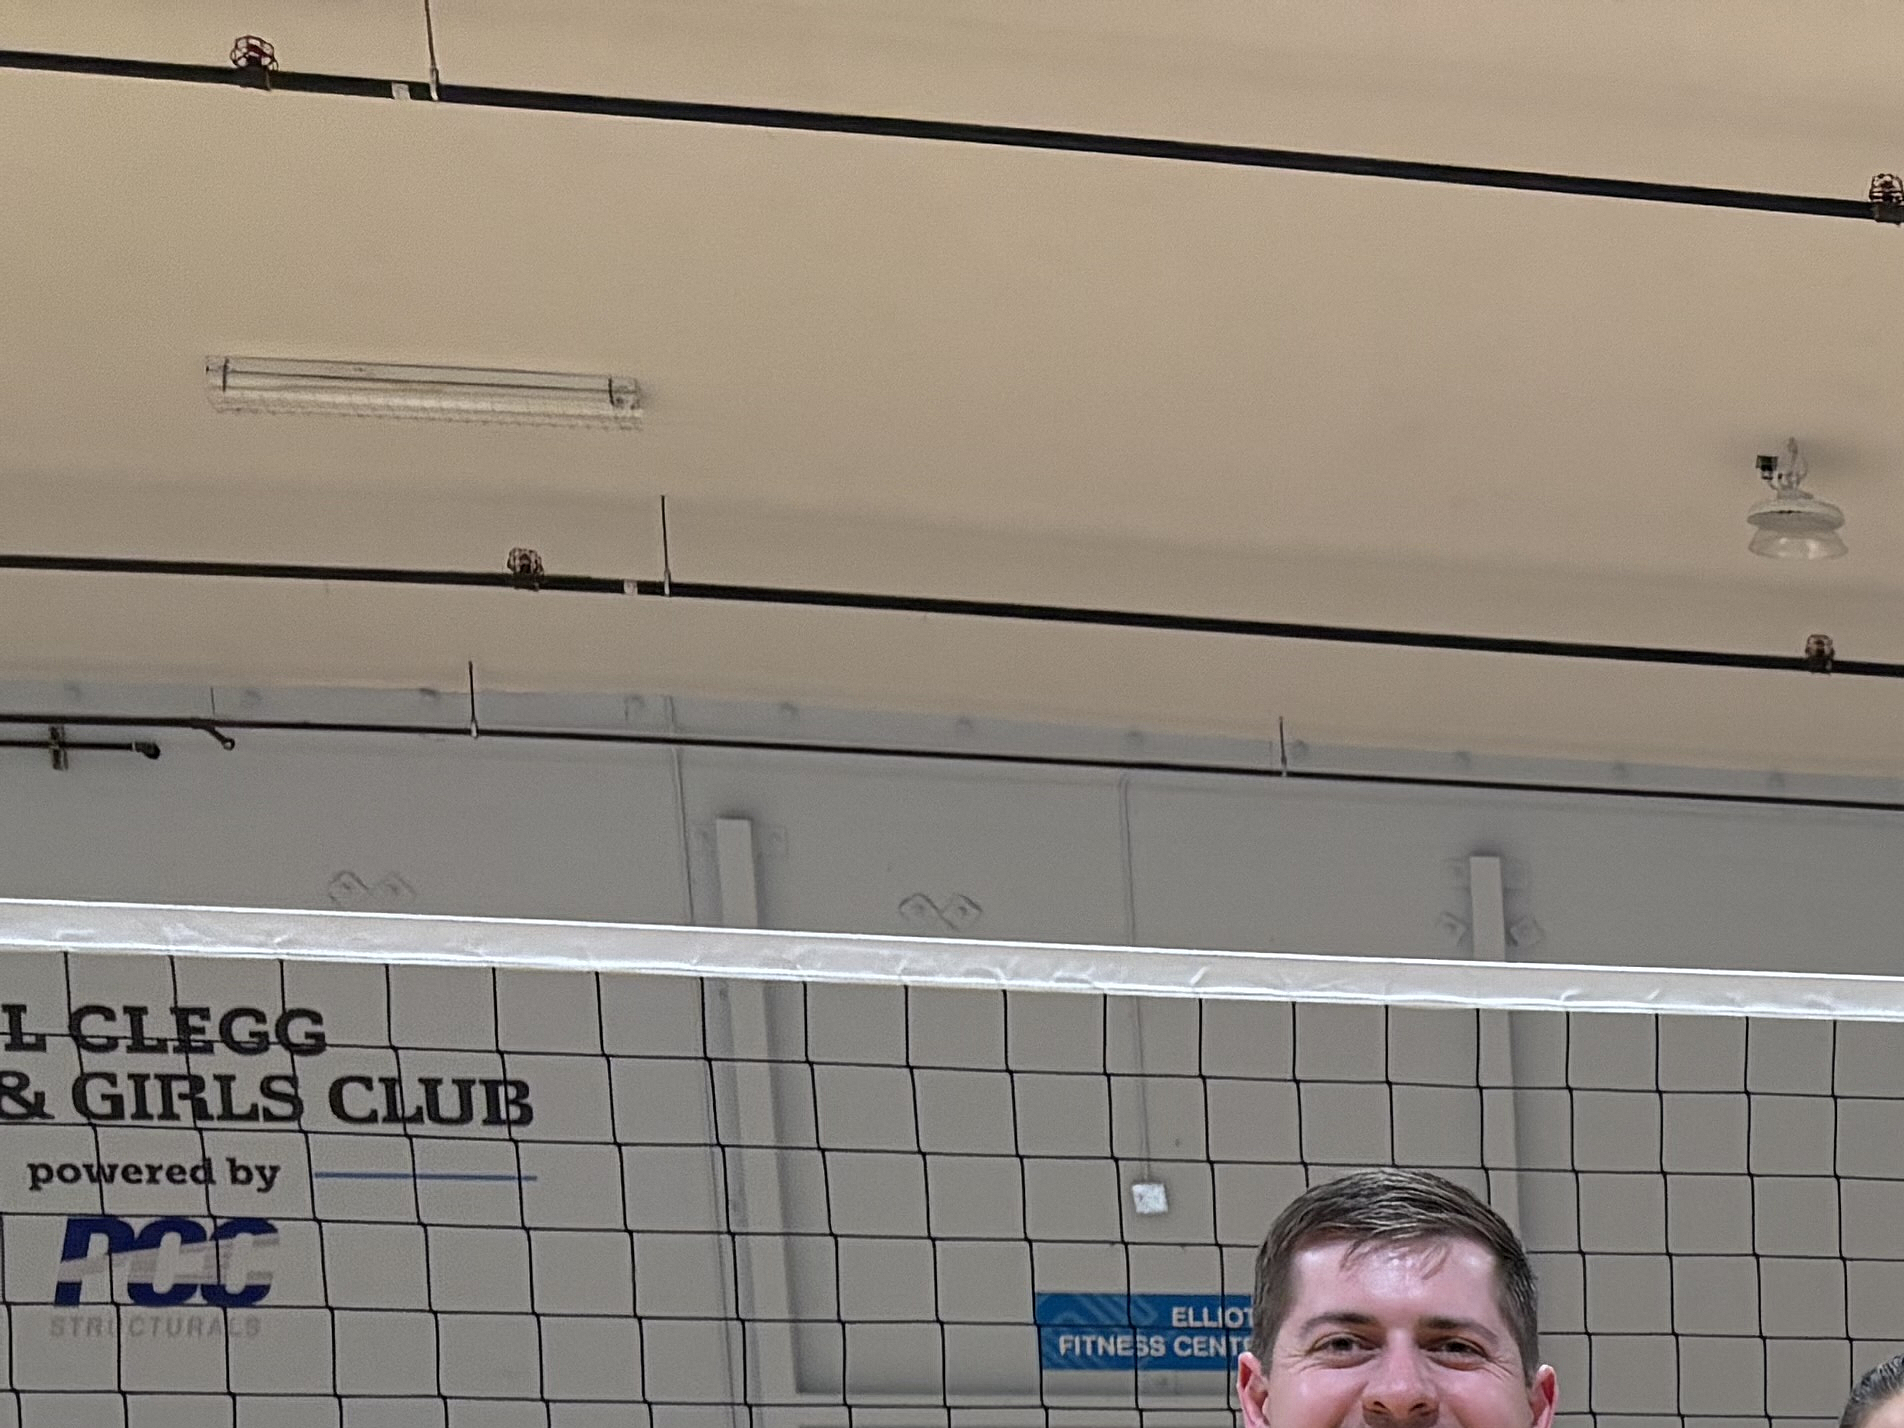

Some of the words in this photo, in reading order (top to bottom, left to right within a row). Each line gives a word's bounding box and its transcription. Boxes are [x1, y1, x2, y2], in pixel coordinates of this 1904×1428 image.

[68, 1004, 328, 1057] CLEGG
[72, 1072, 304, 1123] GIRLS
[328, 1075, 534, 1127] CLUB
[27, 1157, 215, 1192] powered
[226, 1157, 281, 1193] by
[54, 1216, 280, 1308] PCC
[1059, 1334, 1165, 1358] FITNESS
